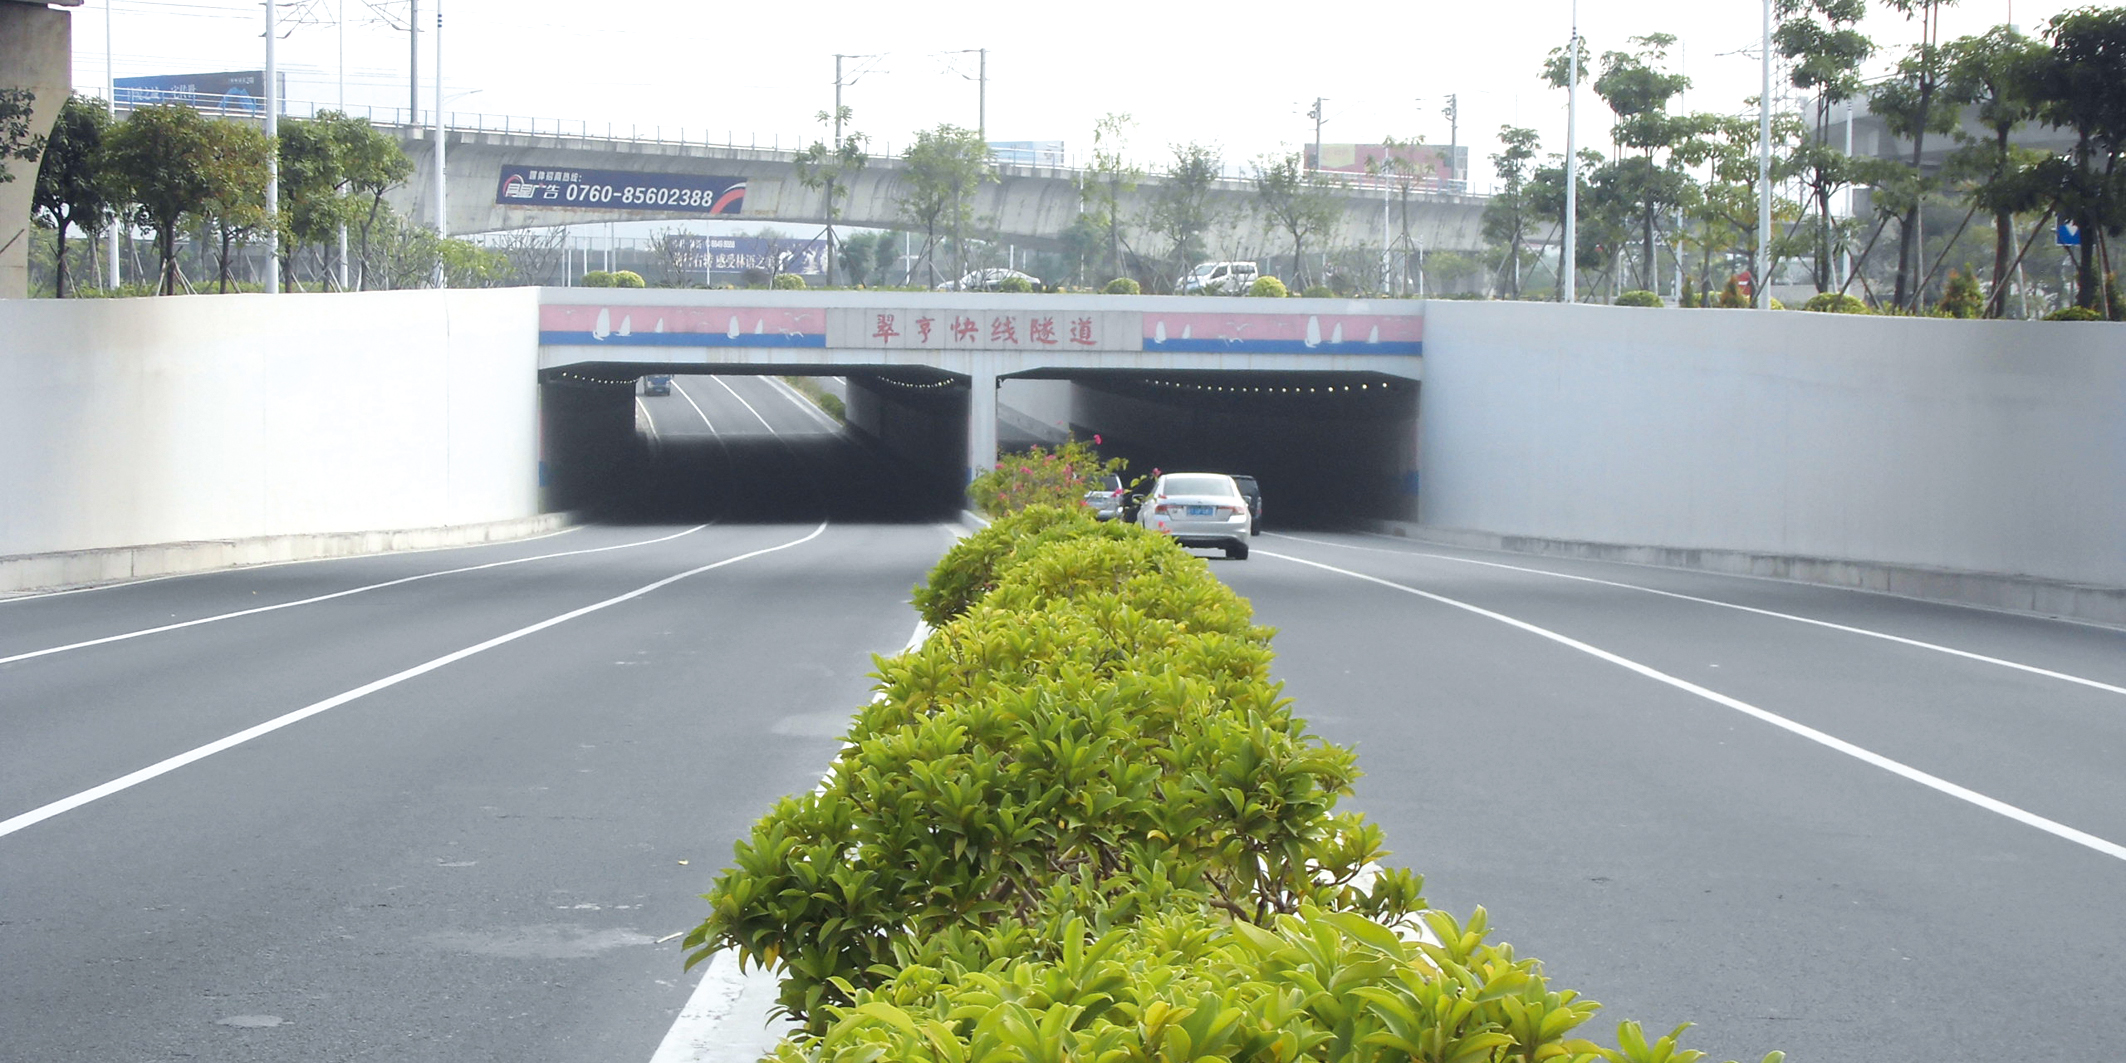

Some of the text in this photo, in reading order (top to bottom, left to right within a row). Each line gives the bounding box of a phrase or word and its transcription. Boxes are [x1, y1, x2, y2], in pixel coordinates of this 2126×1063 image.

[566, 184, 713, 207] 0760-85602388
[872, 314, 1097, 346] 翠亨快线隧道
